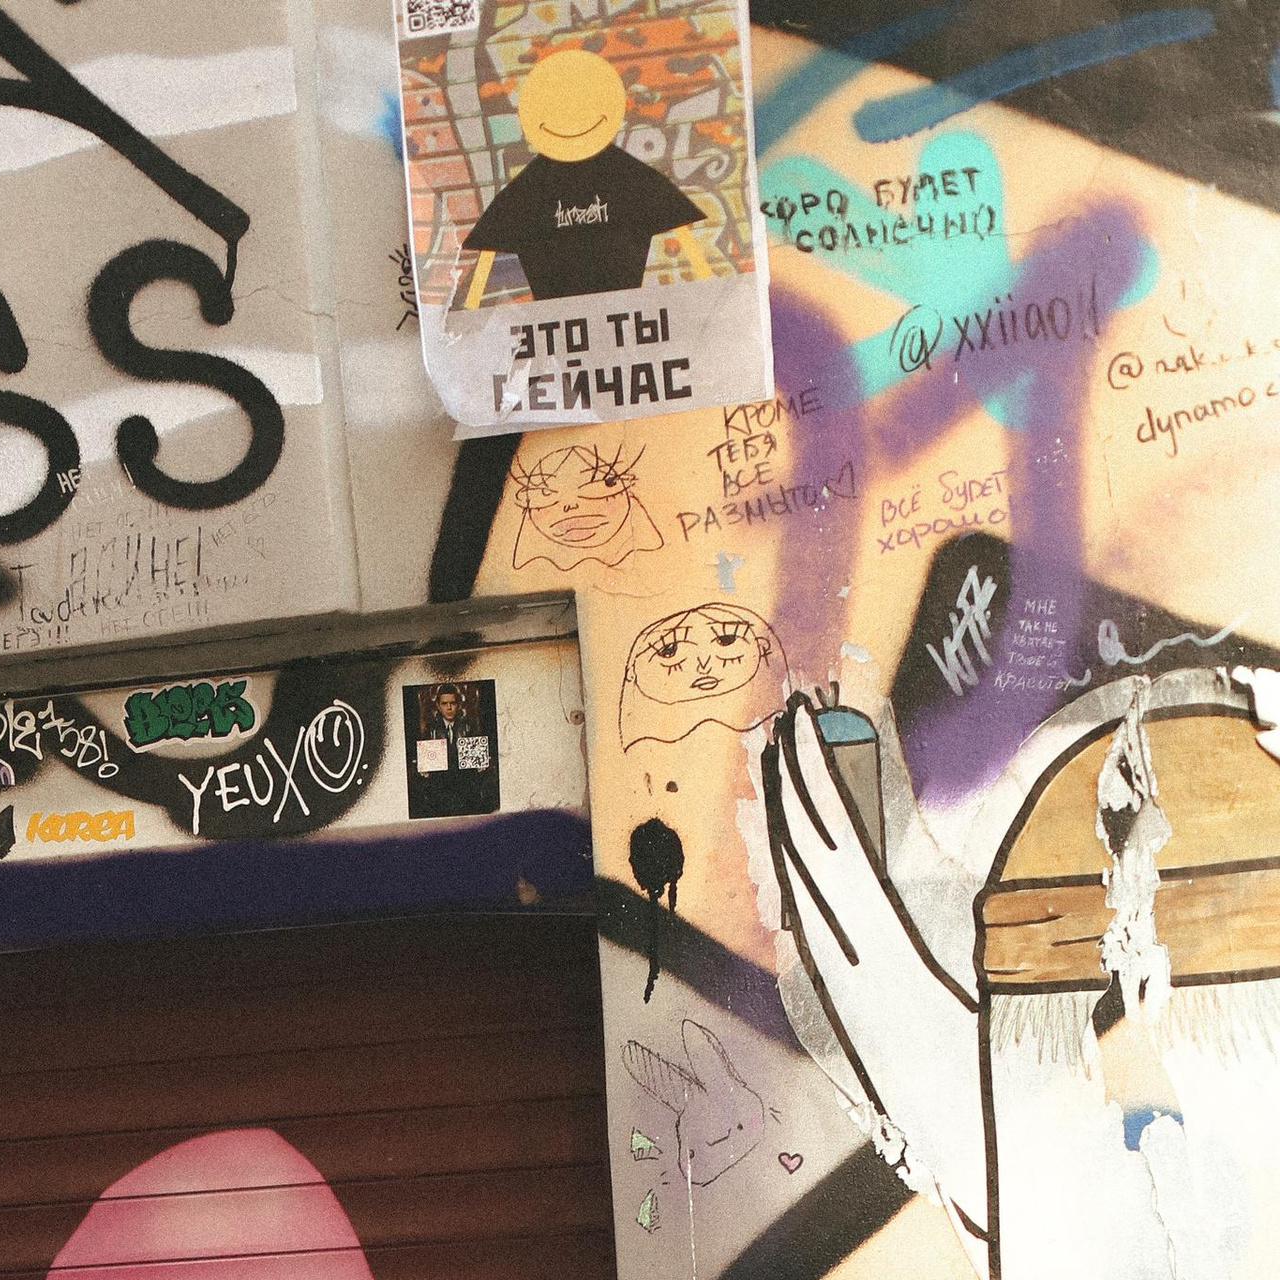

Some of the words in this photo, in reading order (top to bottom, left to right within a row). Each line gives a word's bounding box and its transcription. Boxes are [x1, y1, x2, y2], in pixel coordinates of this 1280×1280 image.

[607, 307, 670, 348] ТЫ
[723, 387, 823, 438] КРОМЕ
[707, 431, 777, 472] ТЕБЯ
[723, 462, 774, 498] ВСЕ
[1023, 599, 1057, 615] МНЕ
[25, 809, 137, 843] KOREA
